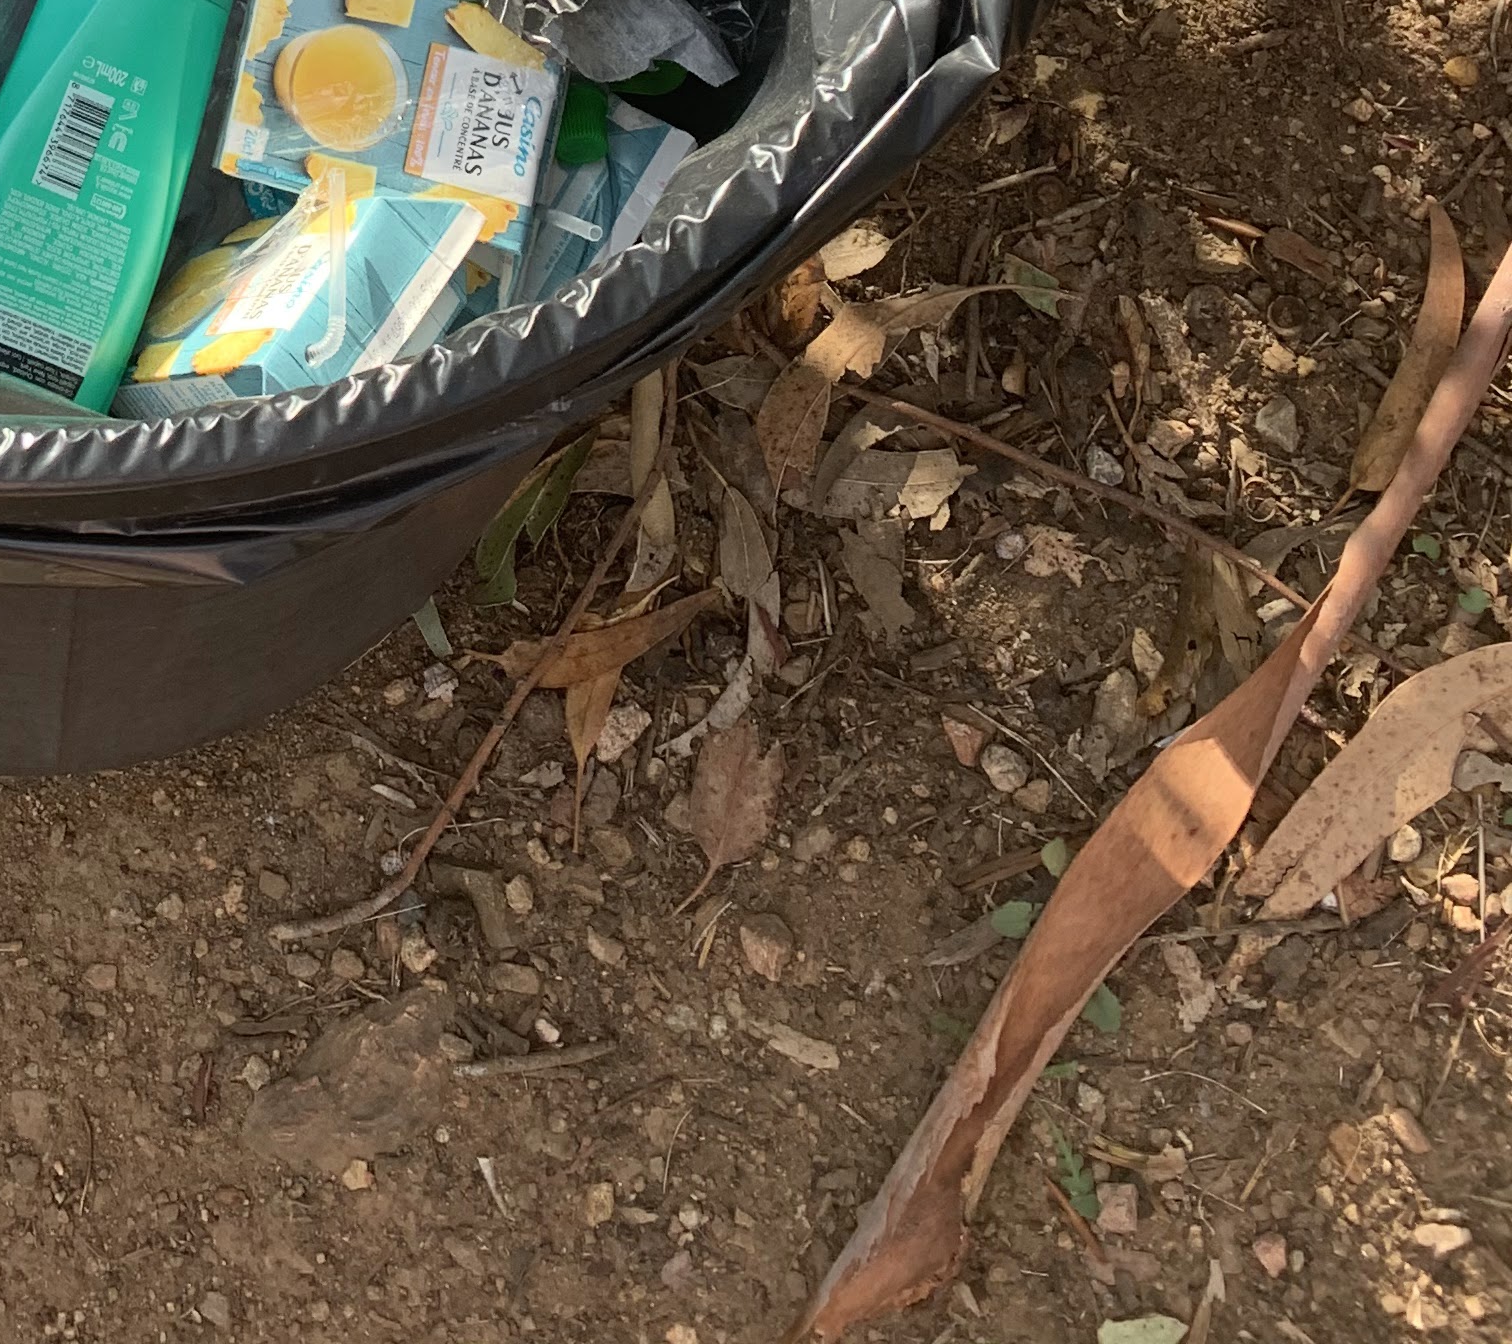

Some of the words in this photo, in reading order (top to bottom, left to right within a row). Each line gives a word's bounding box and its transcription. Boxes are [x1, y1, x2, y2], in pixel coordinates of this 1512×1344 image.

[464, 101, 475, 114] DE
[466, 76, 480, 99] BASE
[53, 94, 76, 134] 717644
[463, 71, 500, 176] D'ANANAS
[488, 108, 517, 150] JUS
[36, 137, 60, 177] 396674
[451, 115, 471, 171] CONCENTRÉ
[513, 95, 545, 178] Casino
[248, 243, 312, 321] D'ANANAS
